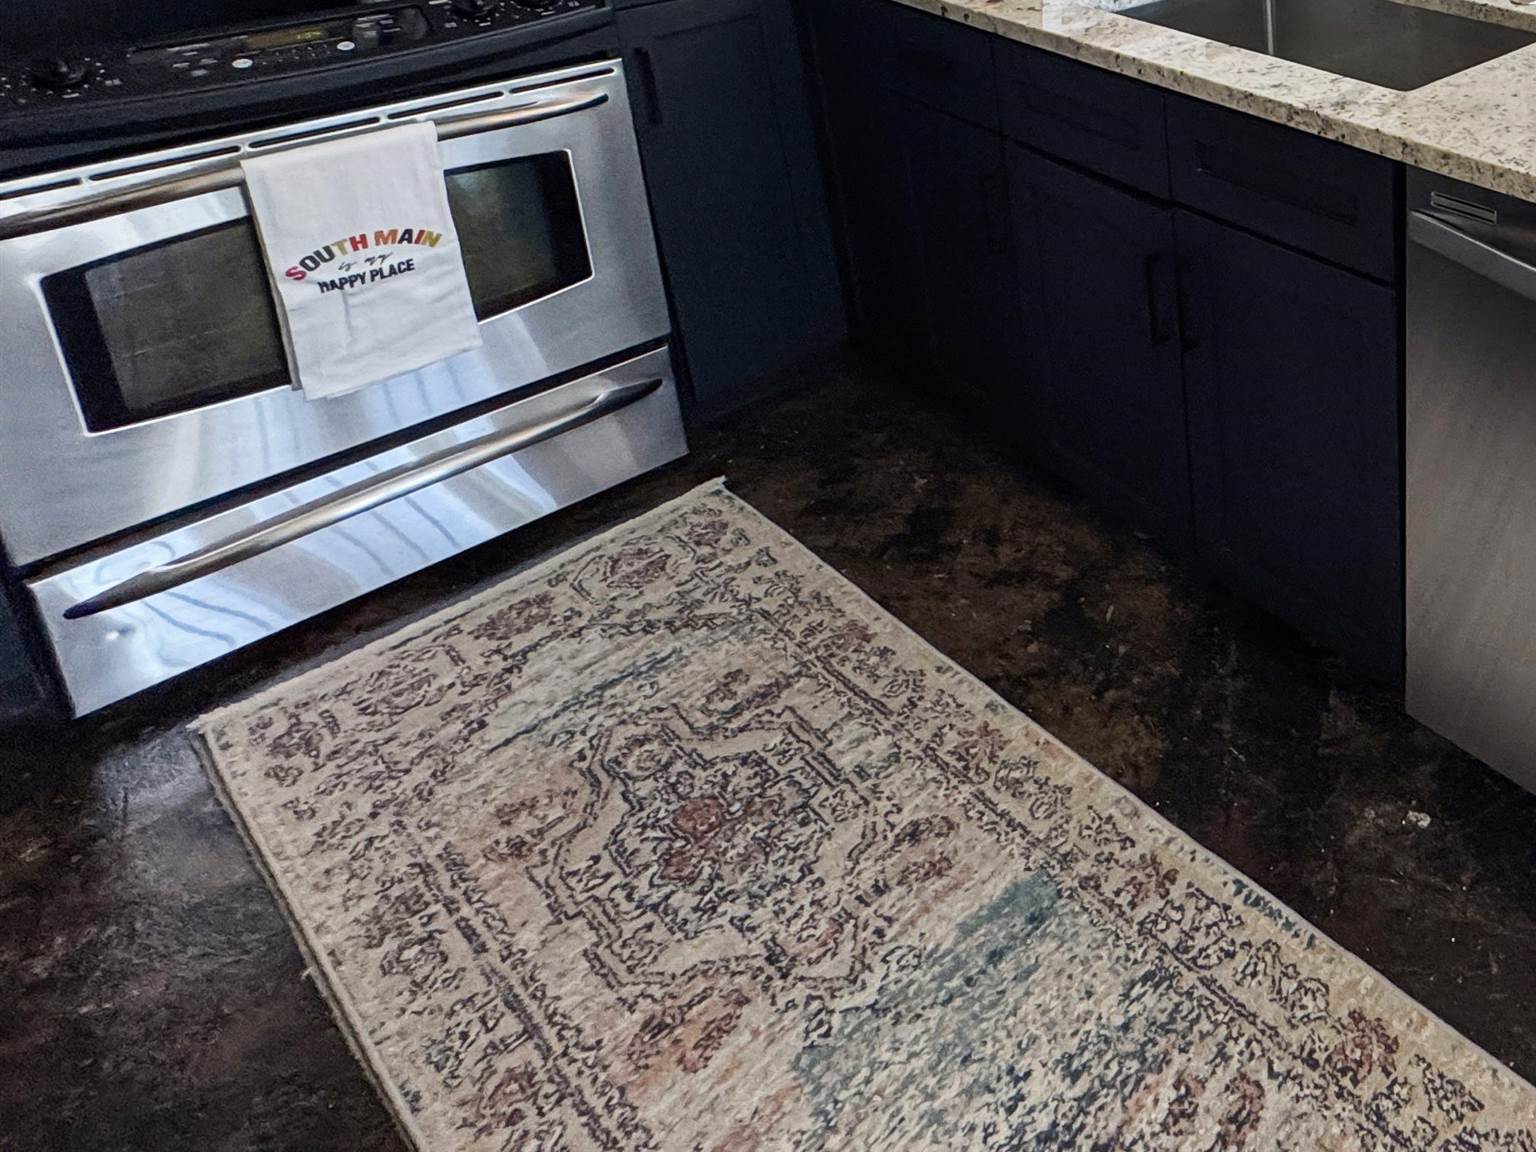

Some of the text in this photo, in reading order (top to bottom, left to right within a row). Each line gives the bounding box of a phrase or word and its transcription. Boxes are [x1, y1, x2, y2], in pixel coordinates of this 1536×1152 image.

[285, 228, 443, 281] SOUTH MAIN
[317, 258, 416, 294] HAPPY PLACE
